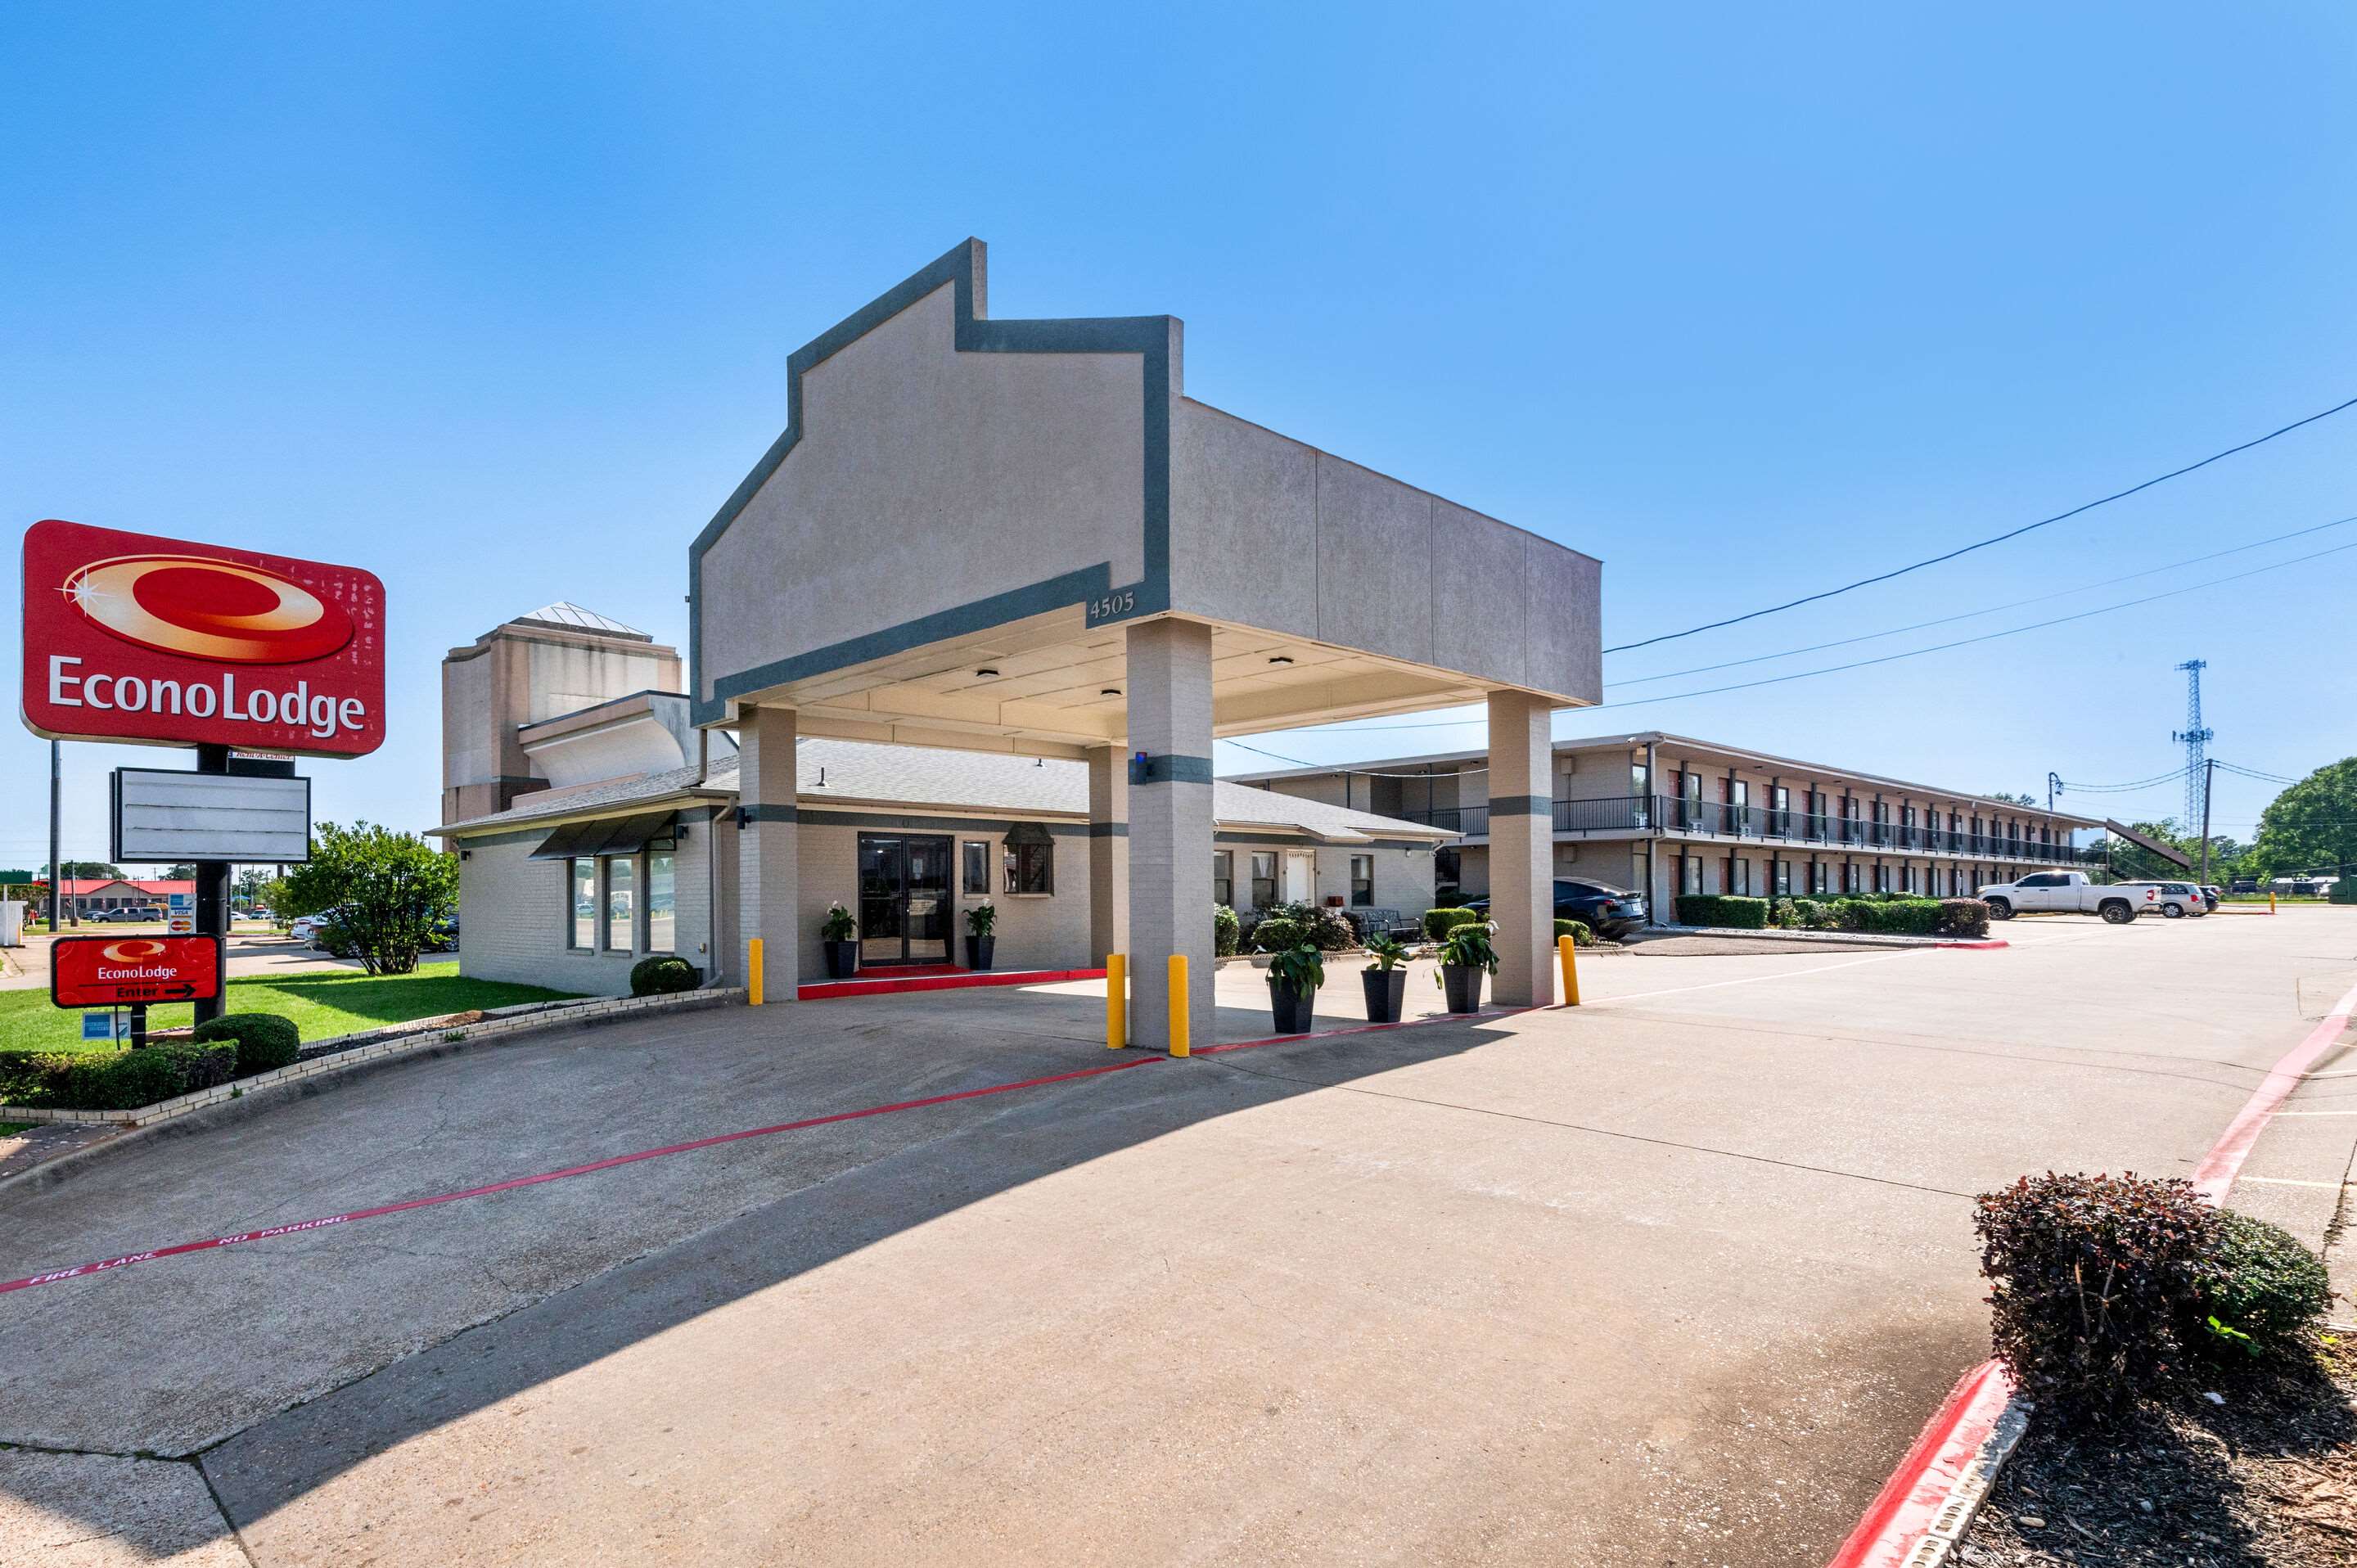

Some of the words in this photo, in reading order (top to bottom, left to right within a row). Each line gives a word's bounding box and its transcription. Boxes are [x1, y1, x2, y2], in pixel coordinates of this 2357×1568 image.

[1090, 591, 1134, 619] 4505
[116, 987, 160, 998] Enter
[29, 1266, 85, 1284] FIRE
[97, 1250, 159, 1270] LANE
[218, 1234, 248, 1245] NO
[260, 1215, 349, 1237] PARKING
